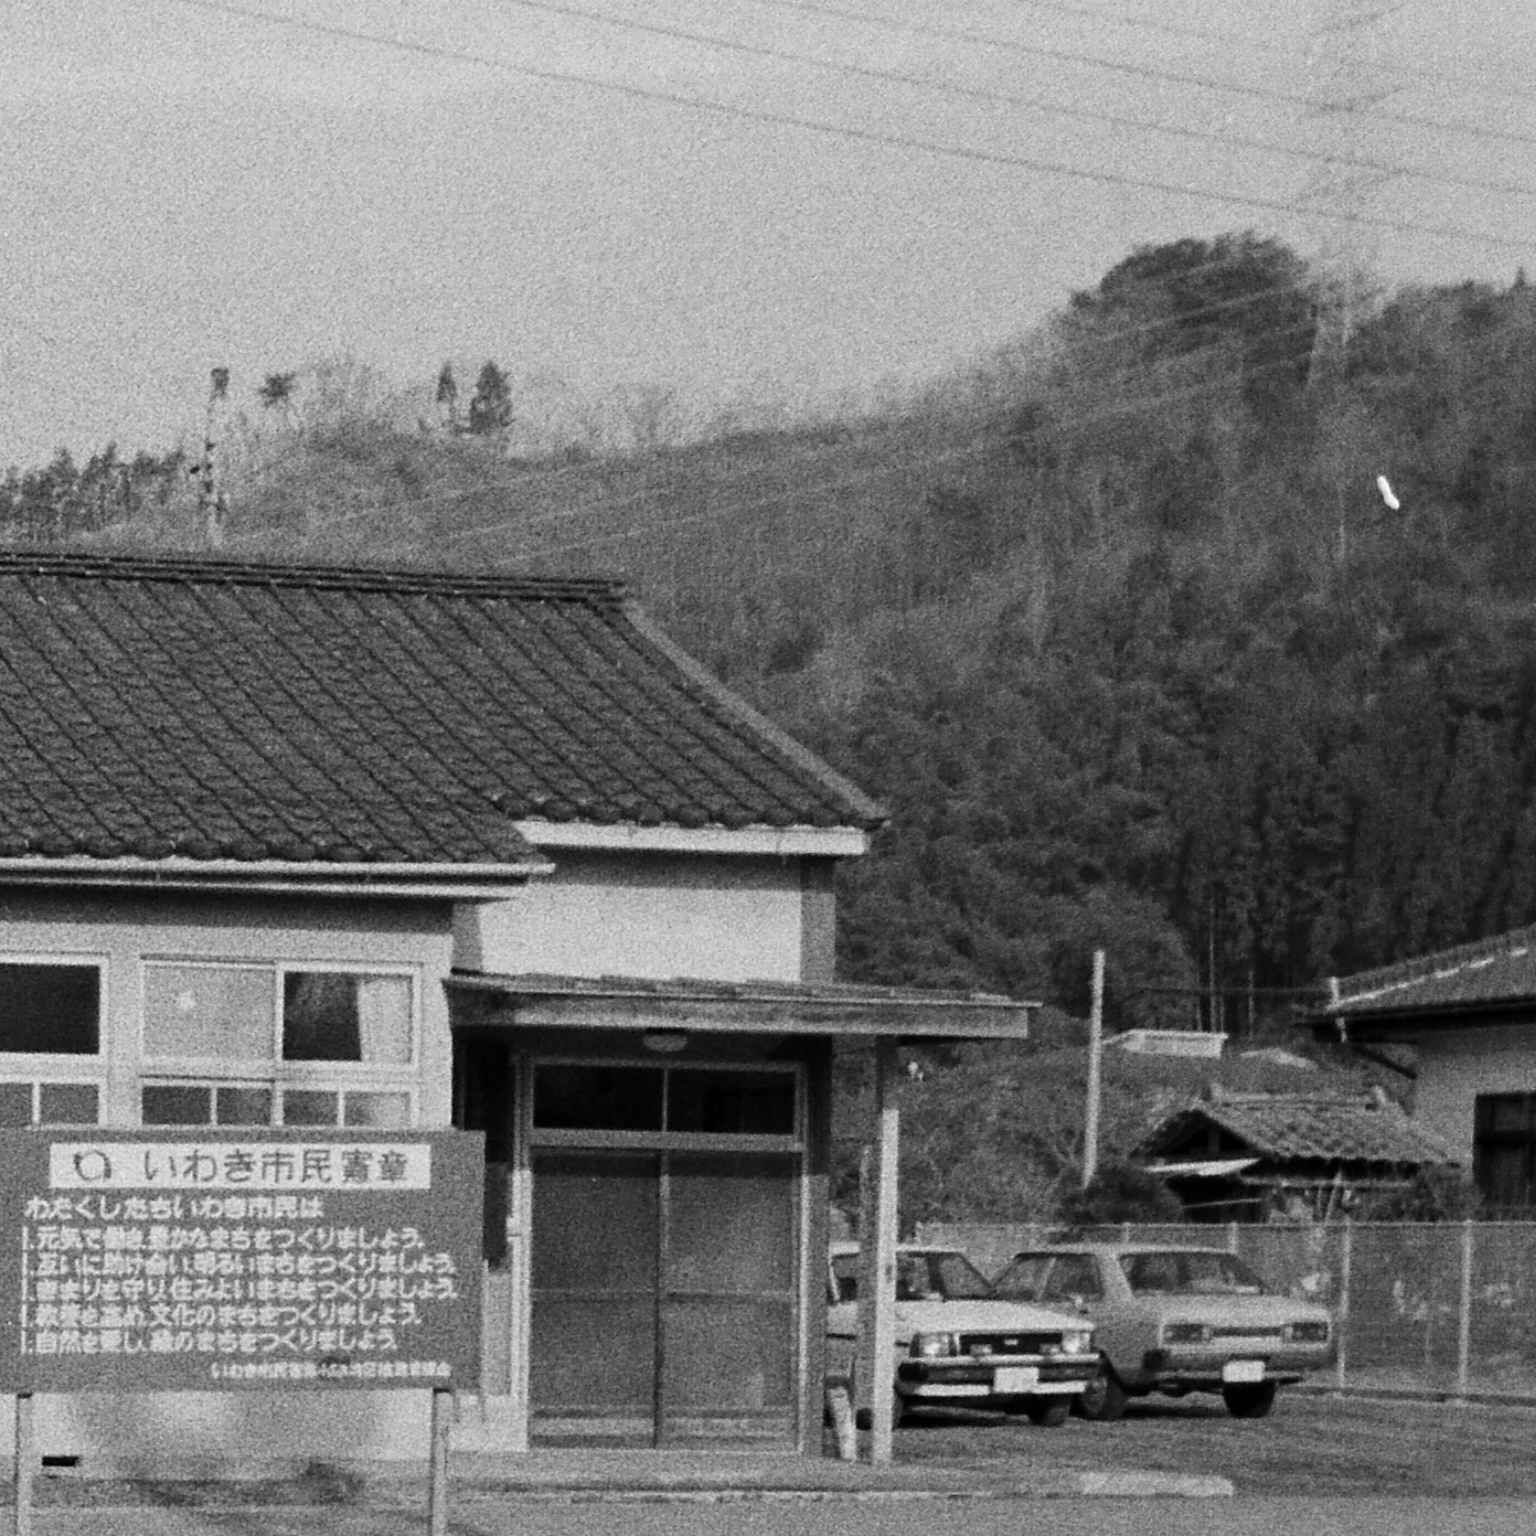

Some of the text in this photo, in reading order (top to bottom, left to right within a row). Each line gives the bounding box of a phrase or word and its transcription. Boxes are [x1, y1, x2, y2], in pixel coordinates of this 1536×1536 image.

[144, 1149, 409, 1183] いわき市民憲章
[24, 1196, 325, 1219] わたくしたちいわき市民は
